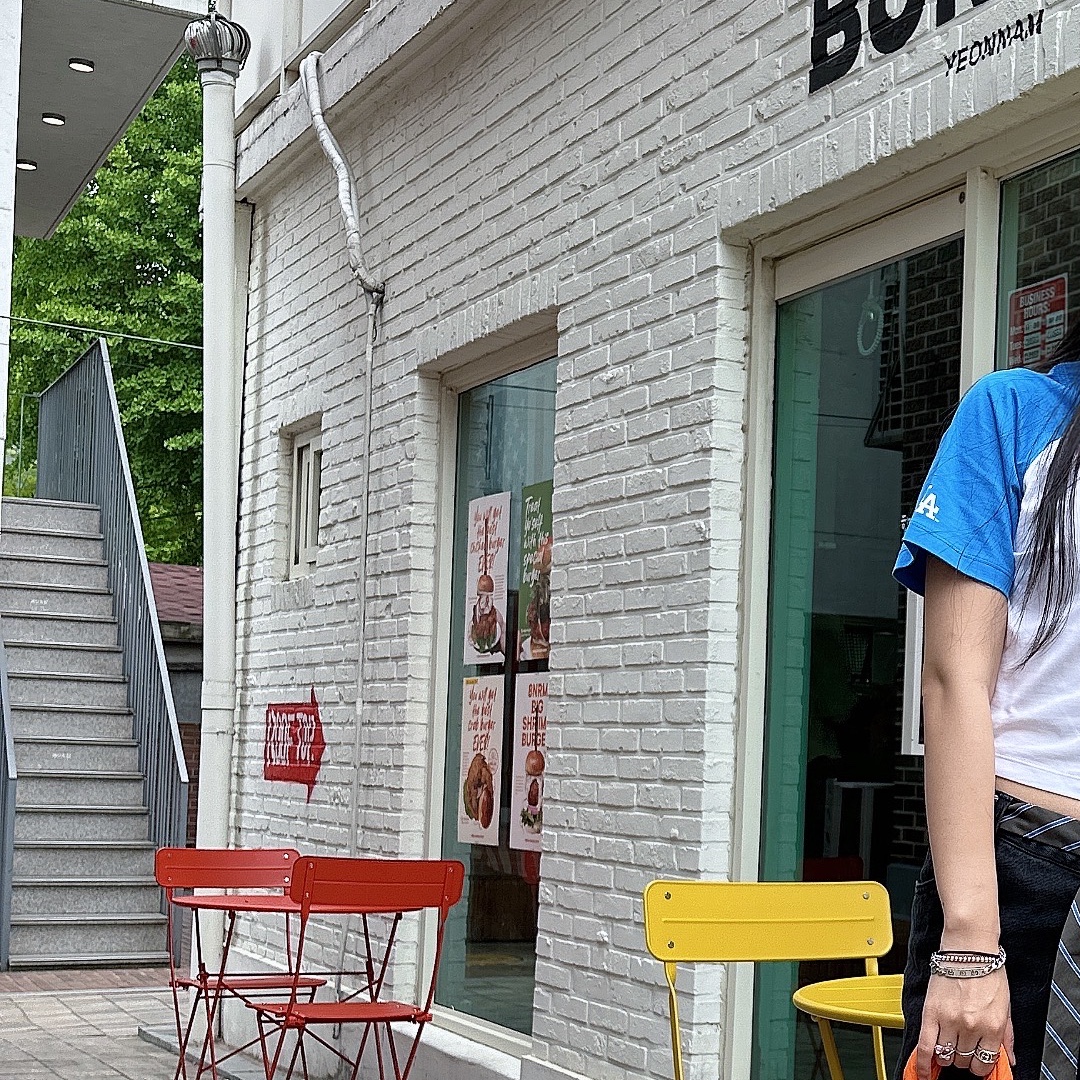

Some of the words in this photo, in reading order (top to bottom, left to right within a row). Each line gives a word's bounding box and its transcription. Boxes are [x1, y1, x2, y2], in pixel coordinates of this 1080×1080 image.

[944, 9, 1044, 77] YEONNAM
[1020, 286, 1056, 308] BUSINESS
[525, 496, 541, 518] Treat
